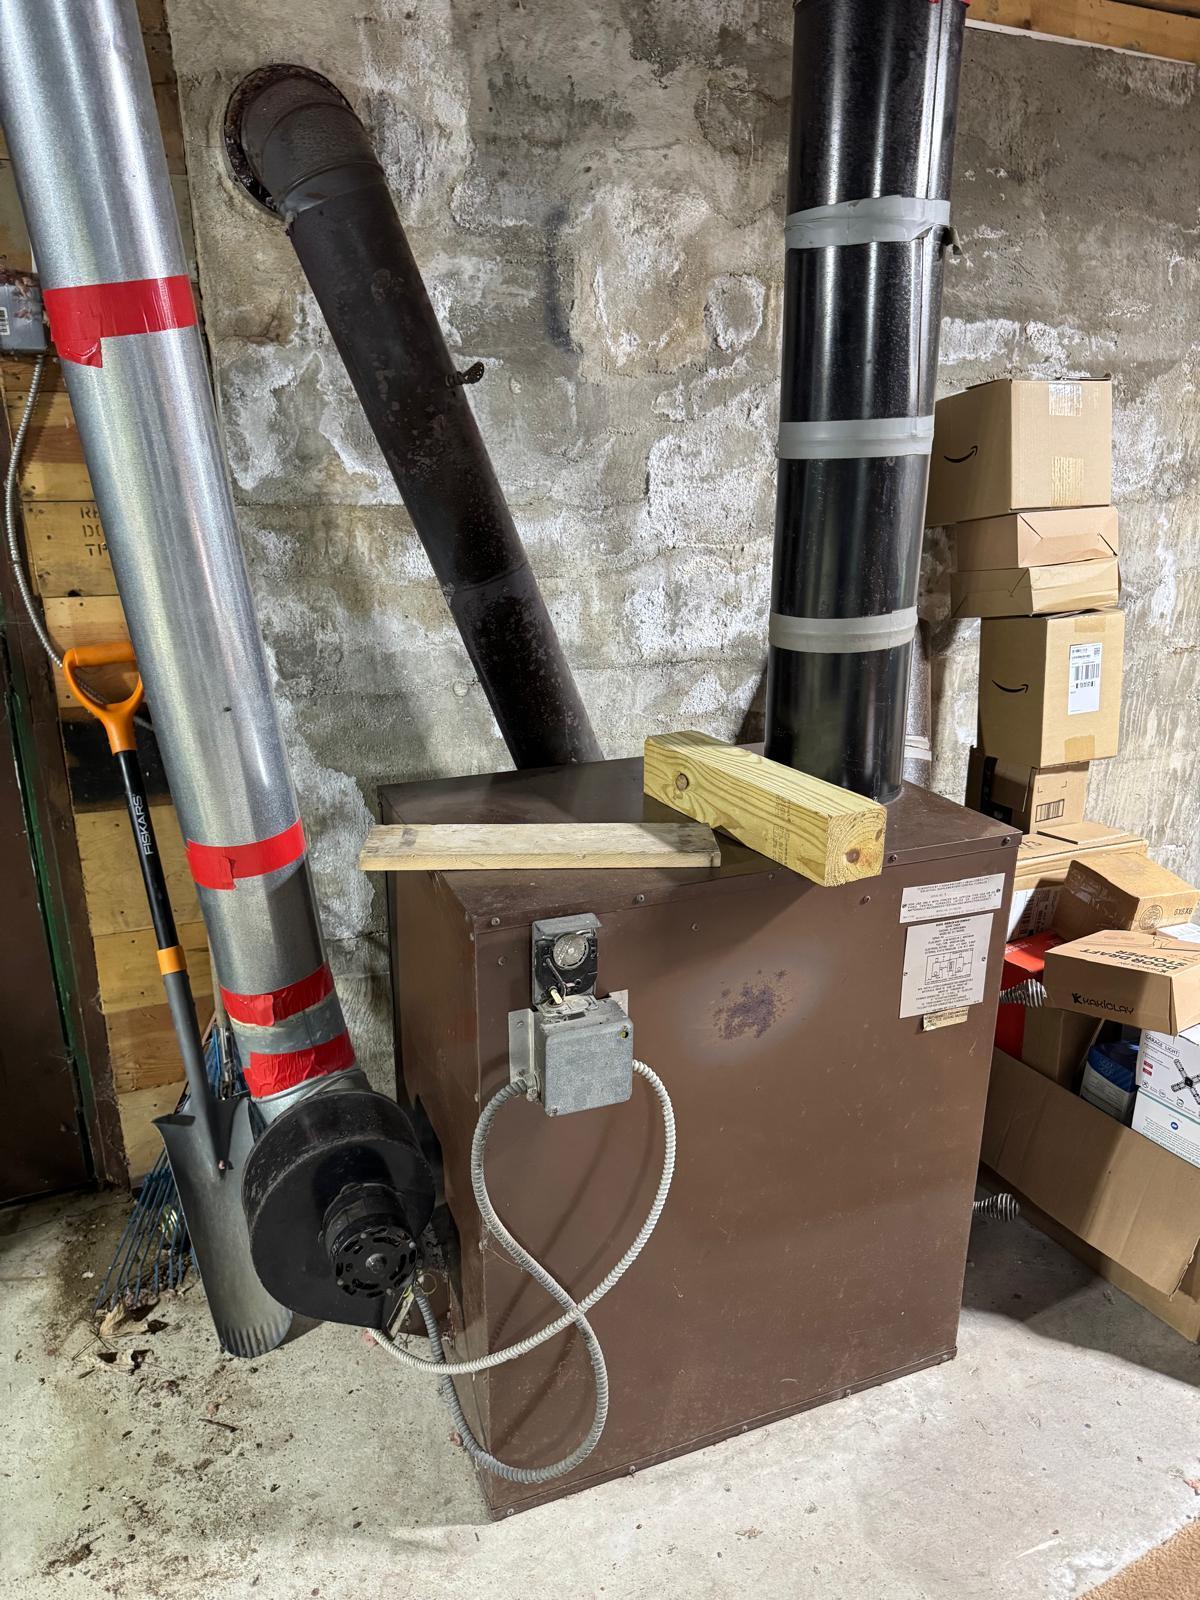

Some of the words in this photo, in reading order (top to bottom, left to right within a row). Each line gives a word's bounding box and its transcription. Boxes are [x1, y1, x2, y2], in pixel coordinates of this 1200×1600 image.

[133, 794, 154, 855] FISKARS
[1079, 949, 1131, 960] DRAFT
[1115, 950, 1188, 967] STOPPER
[1131, 958, 1179, 970] DOOR
[1082, 996, 1135, 1015] KAKICLAY
[1145, 1034, 1163, 1047] GARAGE
[1164, 1045, 1178, 1055] LIGHT
